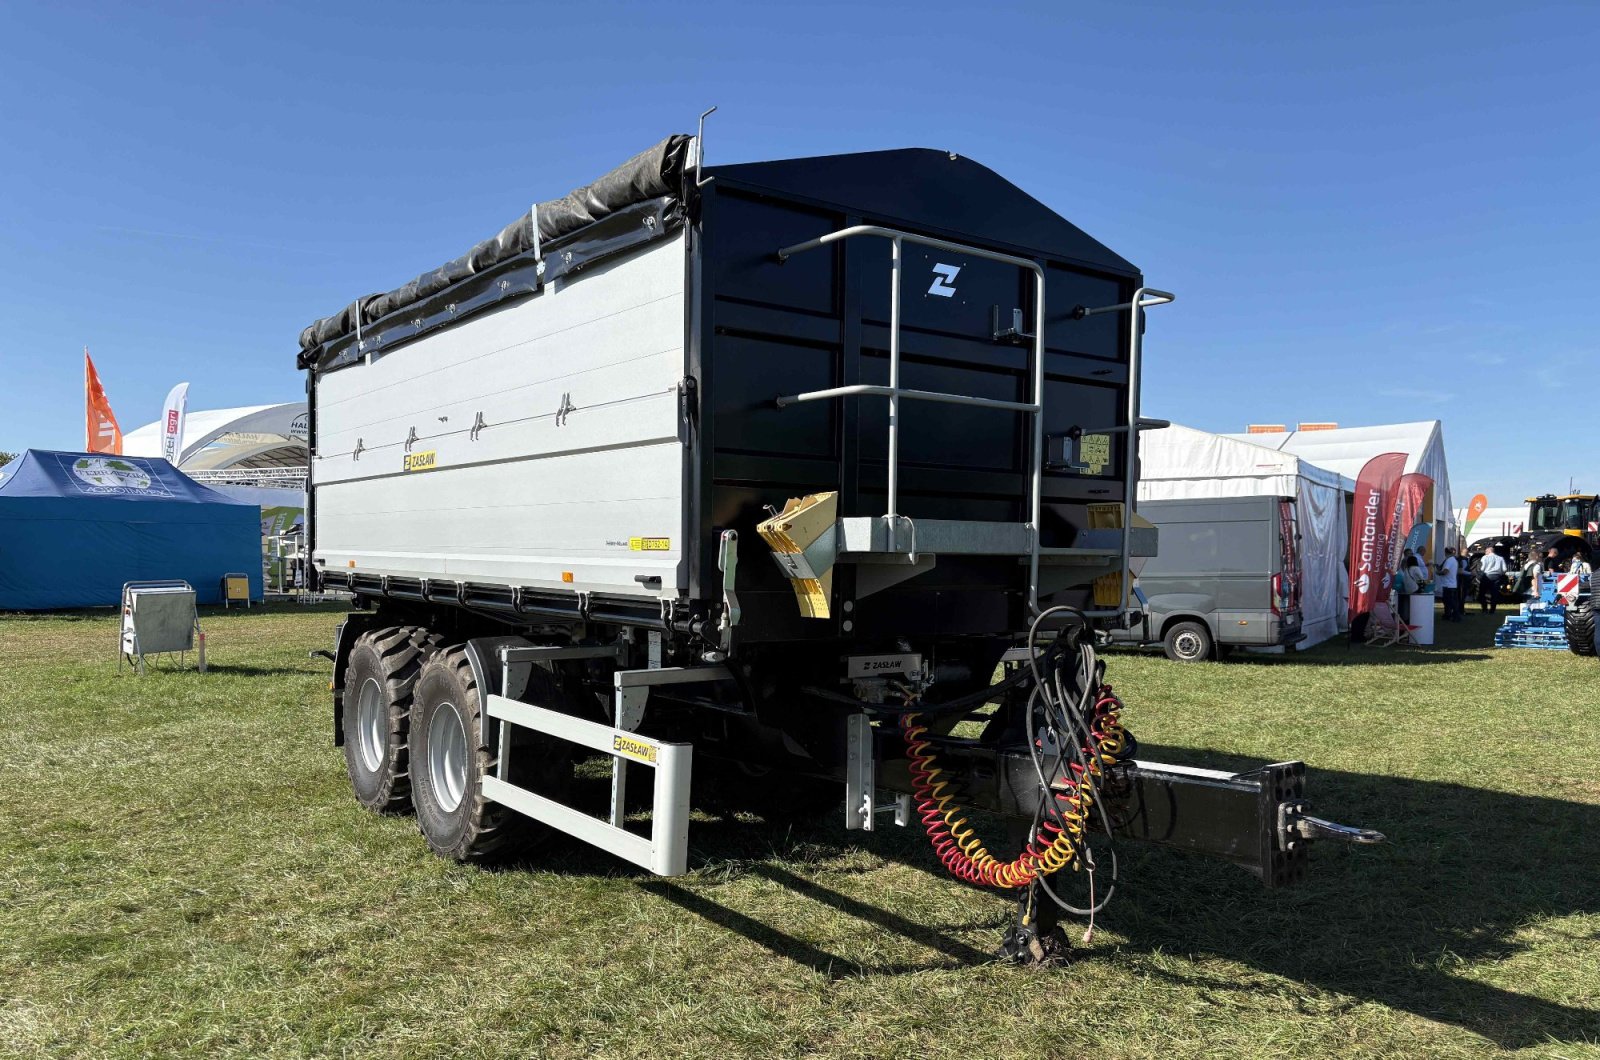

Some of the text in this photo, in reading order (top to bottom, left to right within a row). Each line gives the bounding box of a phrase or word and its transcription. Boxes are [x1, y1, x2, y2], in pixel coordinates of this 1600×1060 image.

[168, 411, 177, 432] agri
[412, 452, 435, 467] ZASŁAW
[1359, 488, 1380, 571] Santander
[1384, 499, 1405, 570] Santander
[1374, 534, 1387, 573] Leasing
[873, 660, 901, 669] ZASŁAW
[622, 740, 649, 757] ZASŁAW
